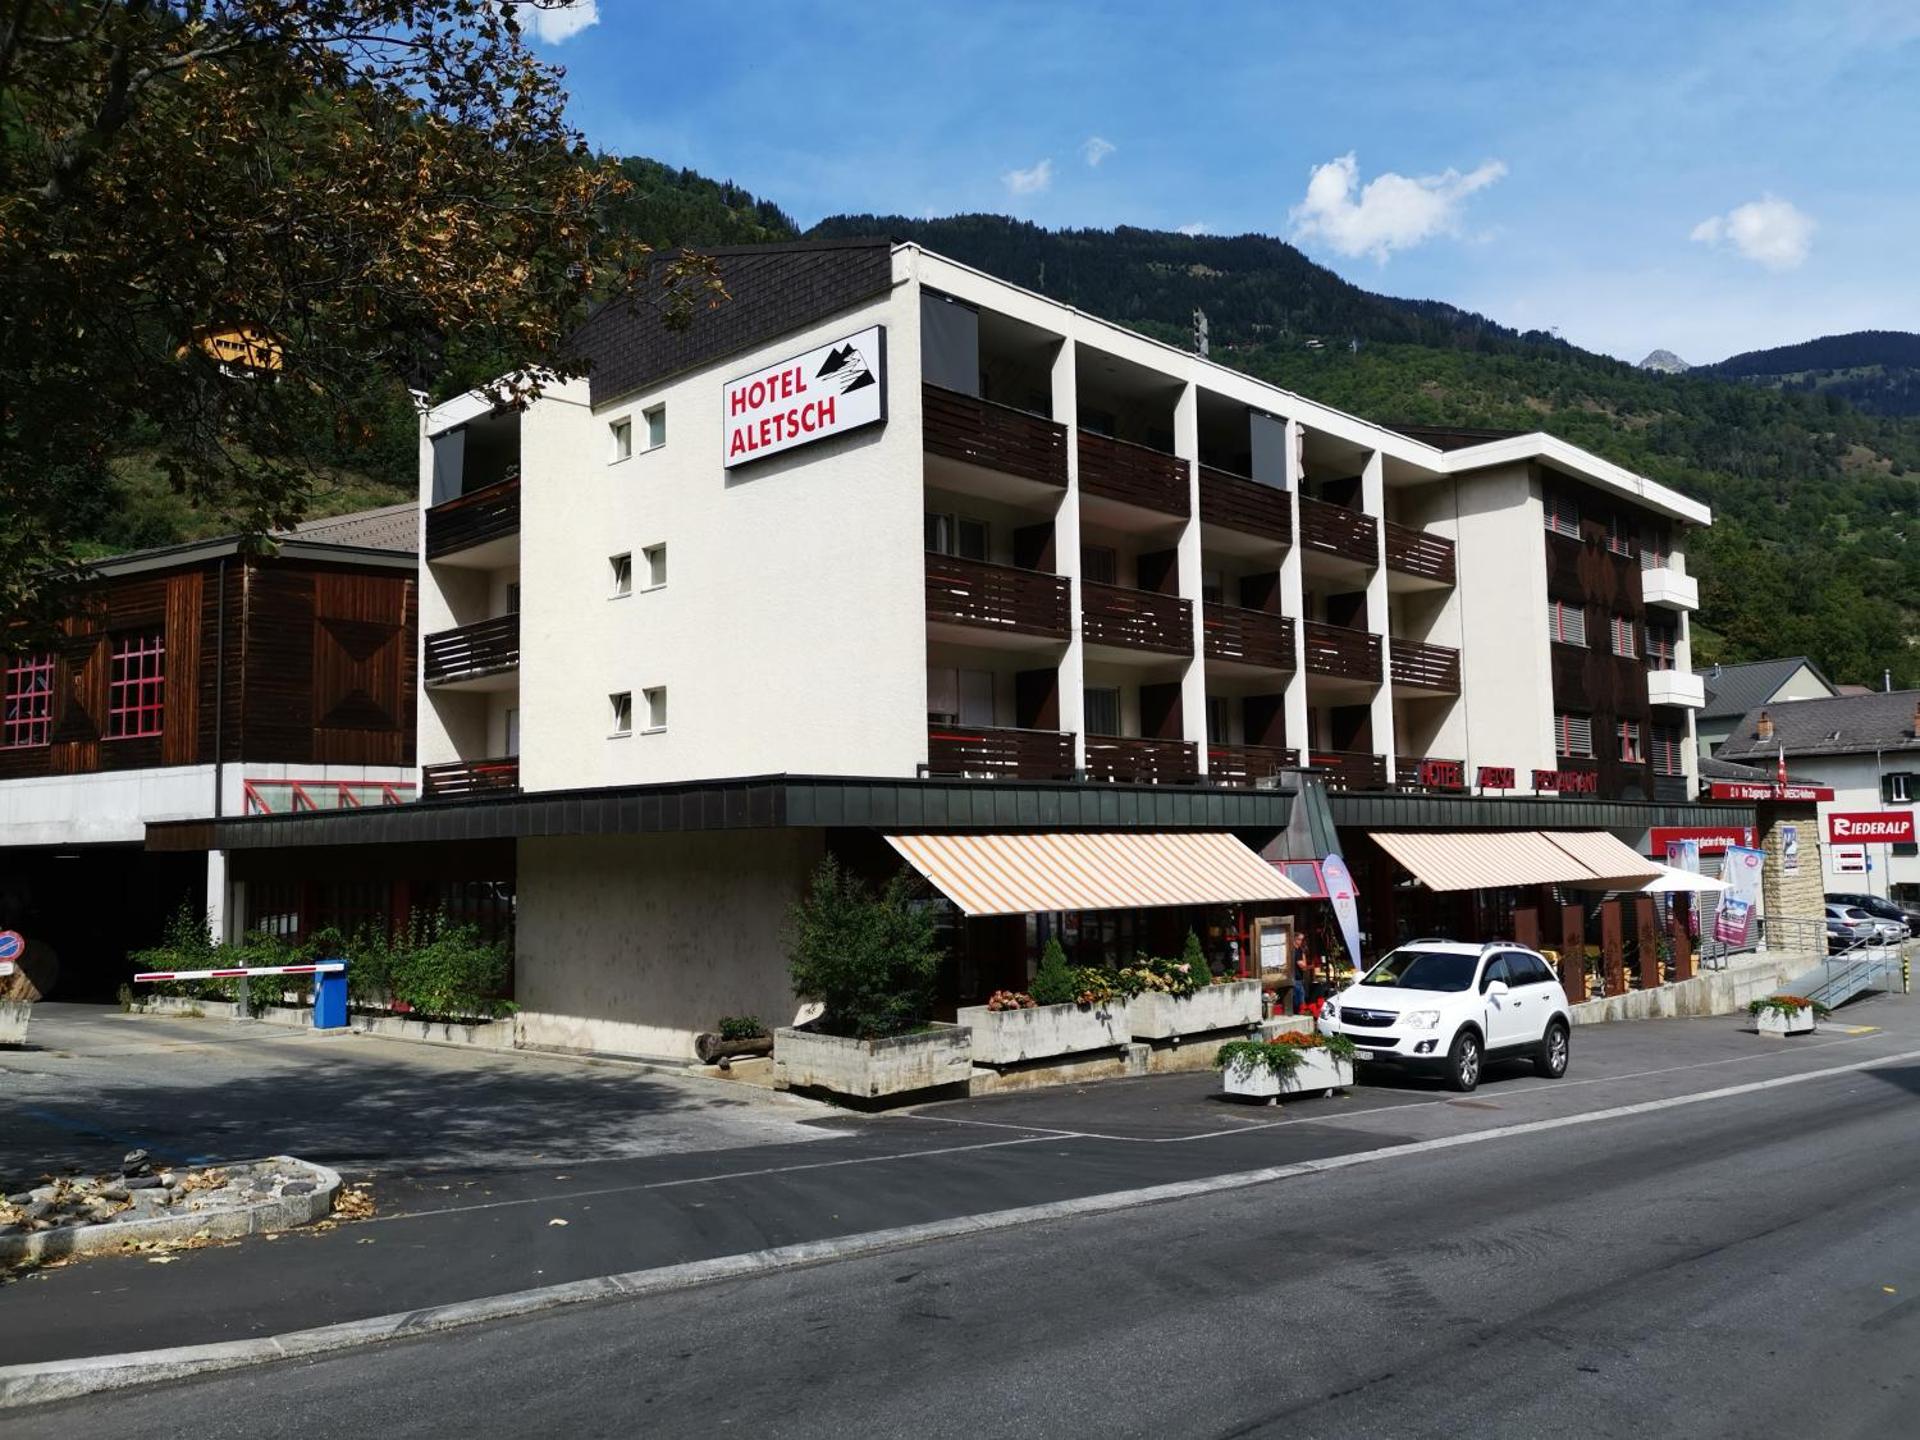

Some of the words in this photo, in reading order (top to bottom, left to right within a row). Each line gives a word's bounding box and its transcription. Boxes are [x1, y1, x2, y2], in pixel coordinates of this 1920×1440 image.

[731, 366, 808, 417] HOTEL
[730, 396, 836, 458] ALETSCH
[1419, 760, 1464, 787] HOTEL
[1535, 770, 1598, 792] RESTAURANT
[1833, 818, 1910, 836] RIEDERALP
